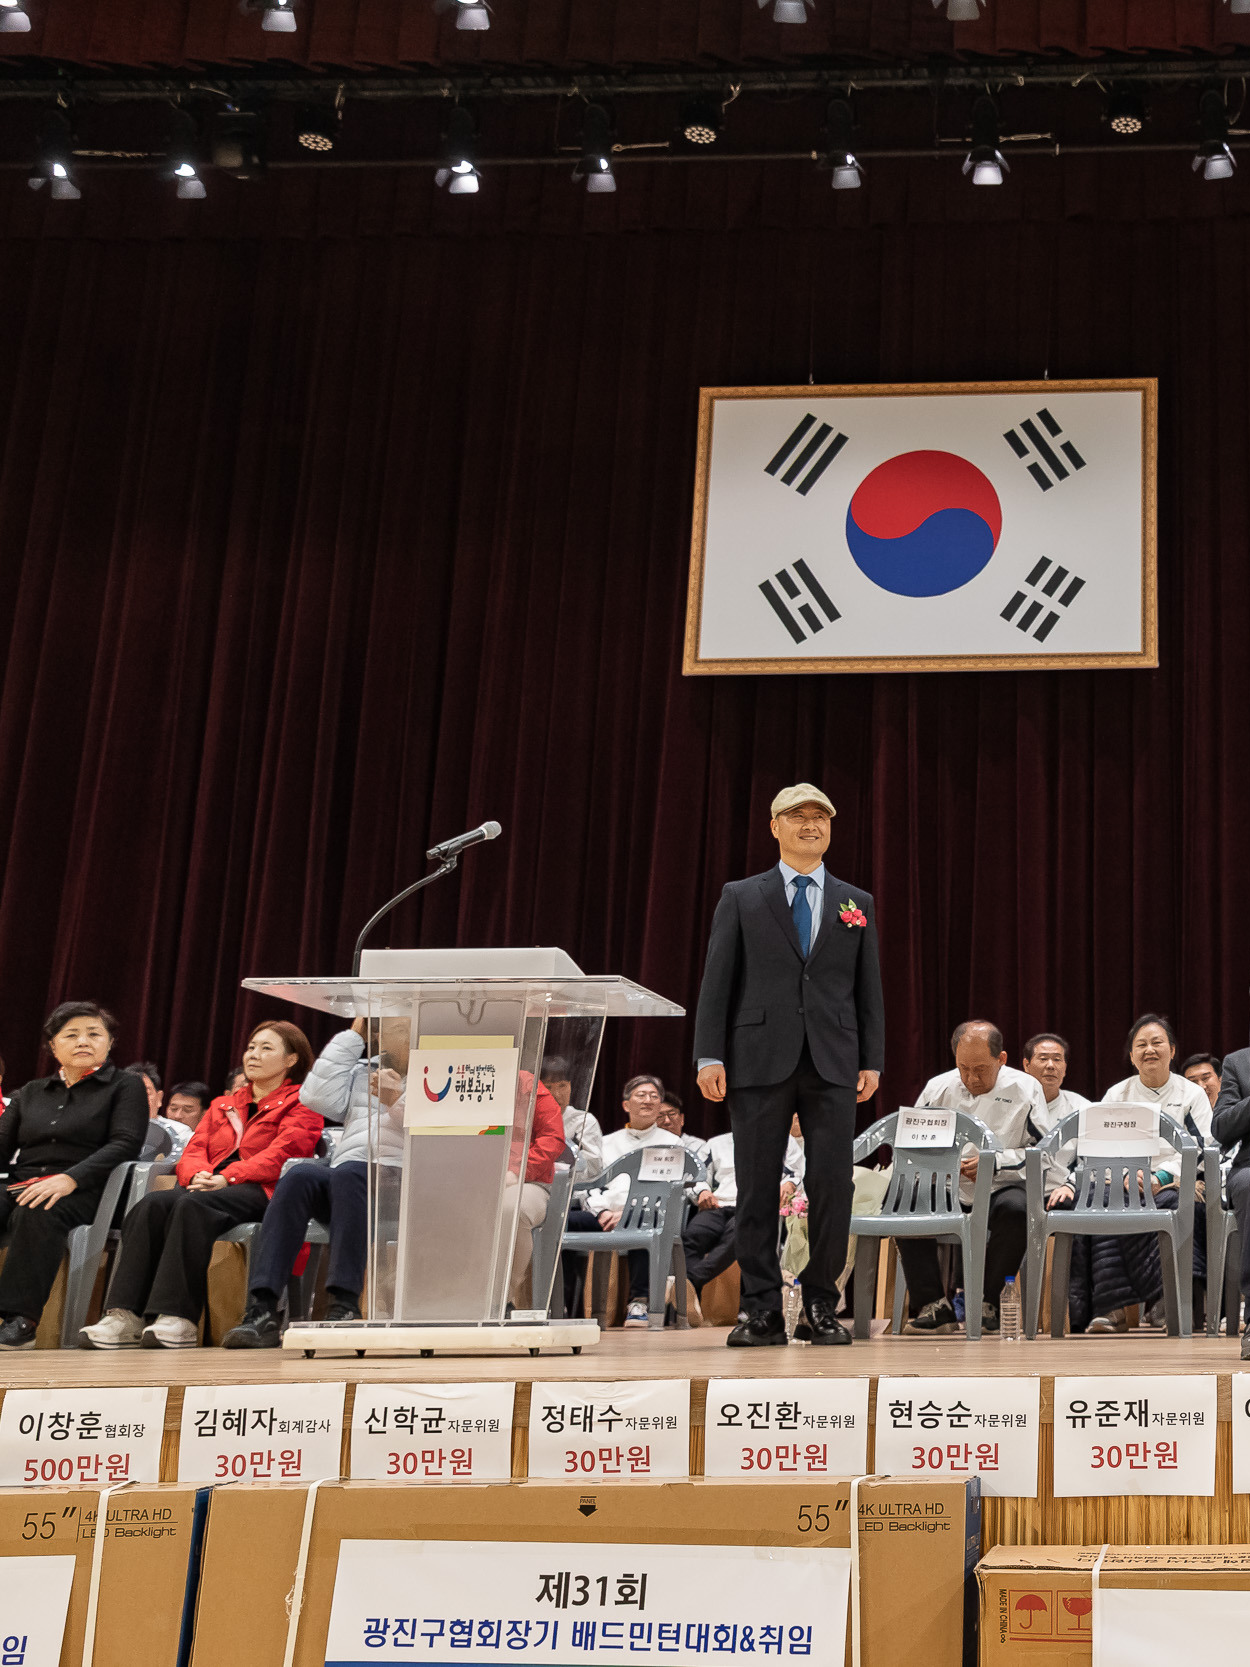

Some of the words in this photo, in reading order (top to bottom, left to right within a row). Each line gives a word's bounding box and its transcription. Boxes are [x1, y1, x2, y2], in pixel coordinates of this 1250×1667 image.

[455, 1077, 495, 1102] 행복광진
[23, 1453, 131, 1482] 500만원
[214, 1448, 302, 1478] 30만원
[386, 1448, 473, 1477] 30만원
[564, 1445, 650, 1474] 30만원
[741, 1443, 827, 1472] 30만원
[911, 1442, 999, 1471] 30만원
[1091, 1441, 1178, 1470] 30만원
[106, 1509, 149, 1521] ULTRA
[152, 1508, 172, 1520] HD
[858, 1503, 875, 1516] 4K
[878, 1503, 921, 1516] ULTRA
[925, 1502, 944, 1515] HD
[114, 1526, 177, 1538] Backlight
[889, 1520, 951, 1533] Backlight
[534, 1571, 649, 1611] 제31회
[362, 1616, 560, 1651] 광진구협회장기
[570, 1618, 815, 1655] 배드민턴대회&취임
